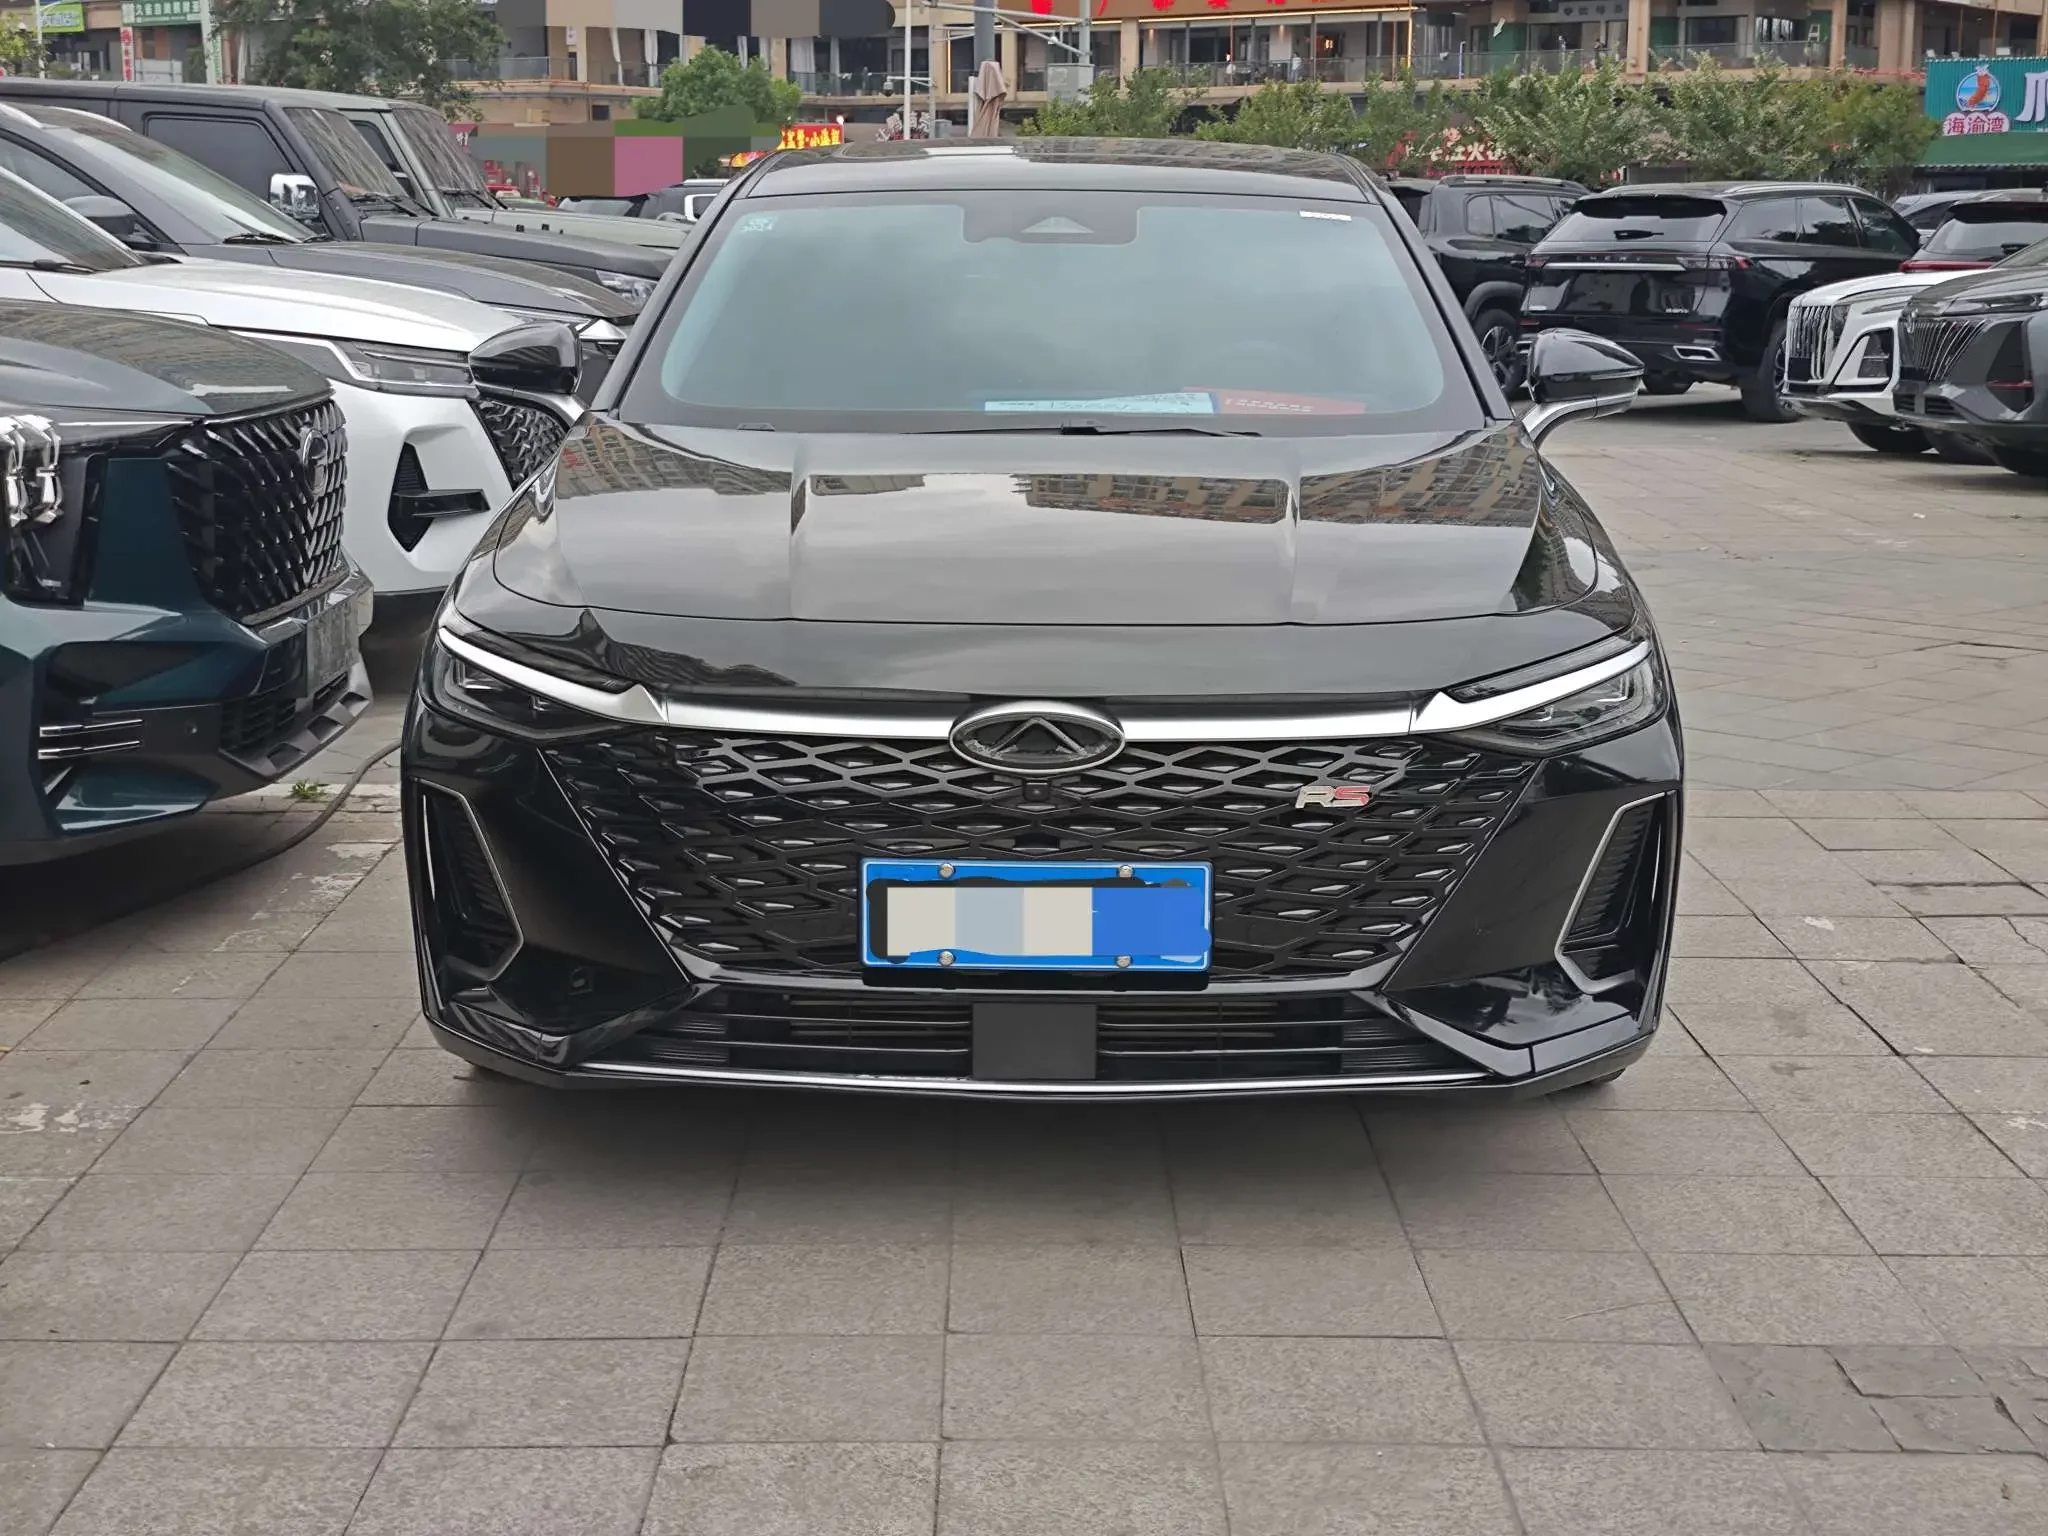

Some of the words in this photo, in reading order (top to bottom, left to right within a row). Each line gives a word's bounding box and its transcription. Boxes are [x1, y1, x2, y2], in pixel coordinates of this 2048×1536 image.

[1947, 115, 2005, 135] 海渝湾
[1294, 785, 1370, 808] RS
